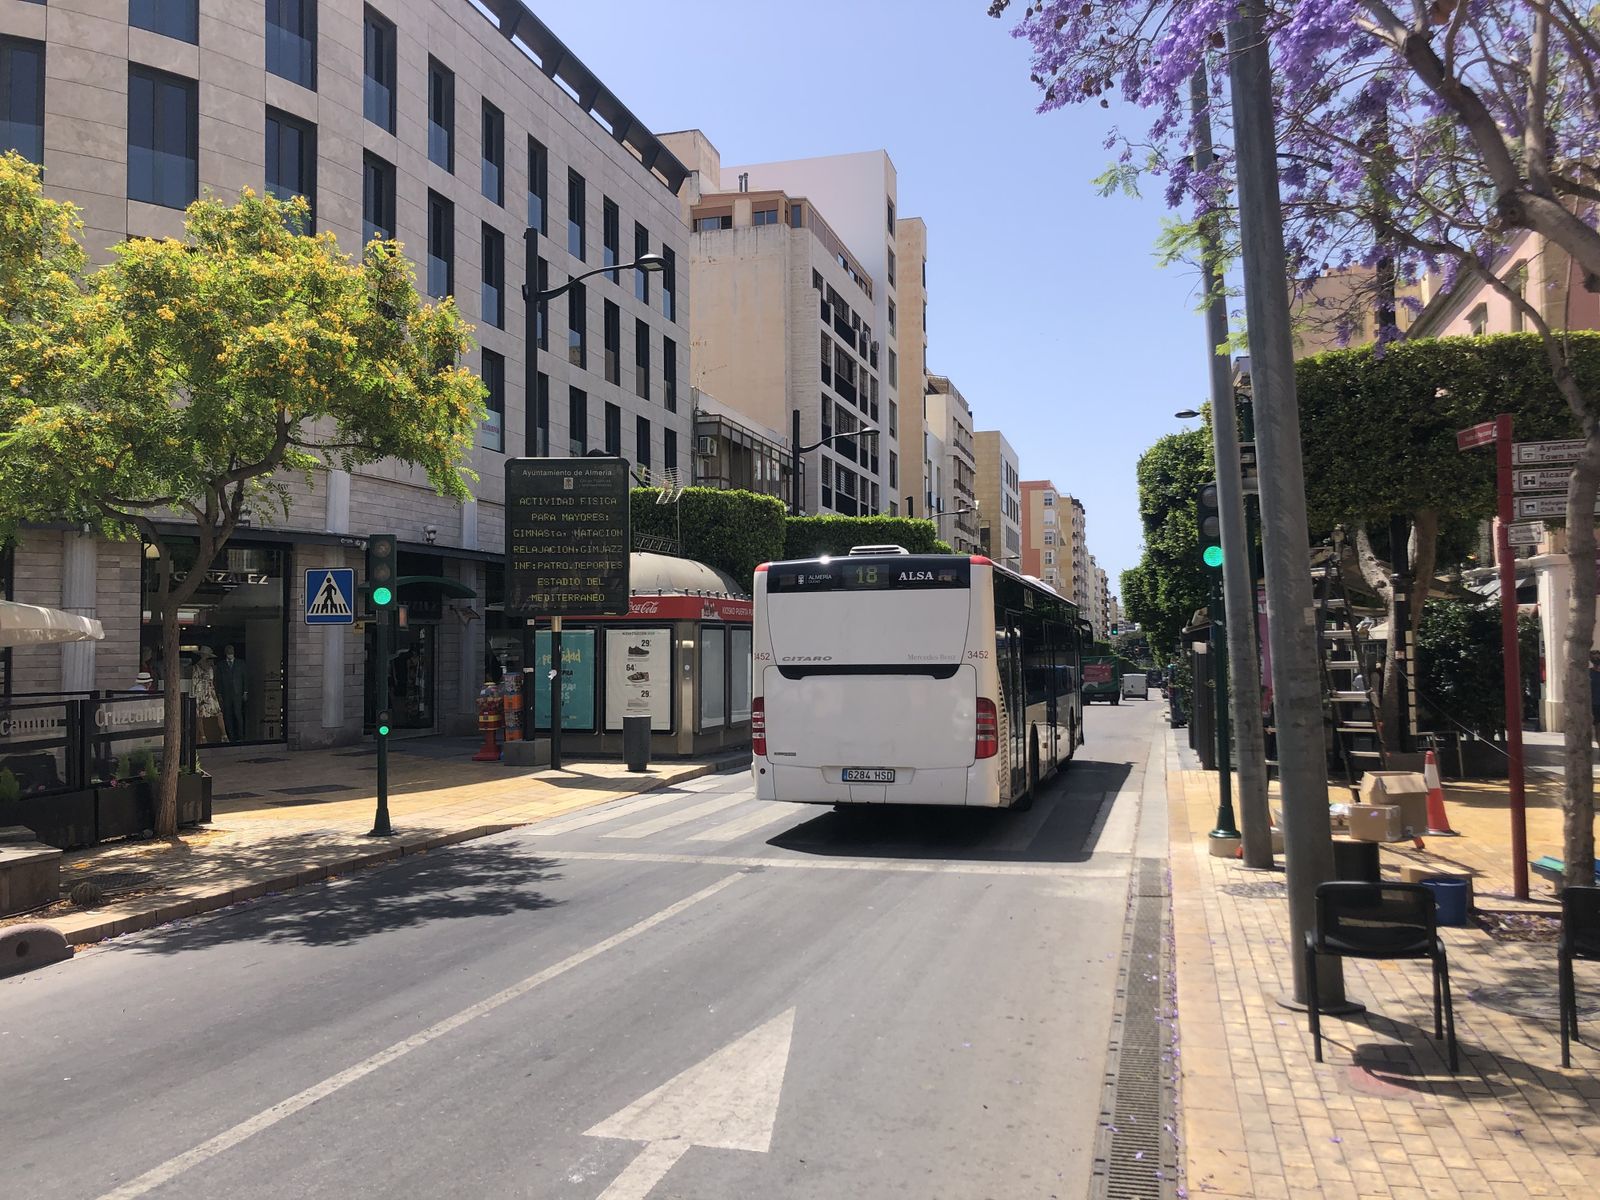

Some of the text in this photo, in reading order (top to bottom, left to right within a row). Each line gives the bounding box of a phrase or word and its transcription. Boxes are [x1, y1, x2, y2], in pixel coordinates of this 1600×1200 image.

[519, 497, 617, 506] ACTIVIDAD FISICA
[531, 513, 609, 521] PARA MAYORES:
[574, 529, 623, 538] NATACION
[174, 571, 269, 585] GNZAEZ
[856, 566, 878, 584] 18
[898, 571, 934, 581] ALSA
[537, 577, 605, 586] ESTADIO DEL
[531, 593, 605, 602] MEDITERRANEO
[967, 650, 989, 660] 3452
[95, 703, 164, 728] Cruzcamp
[848, 771, 893, 780] 6284 HSD
